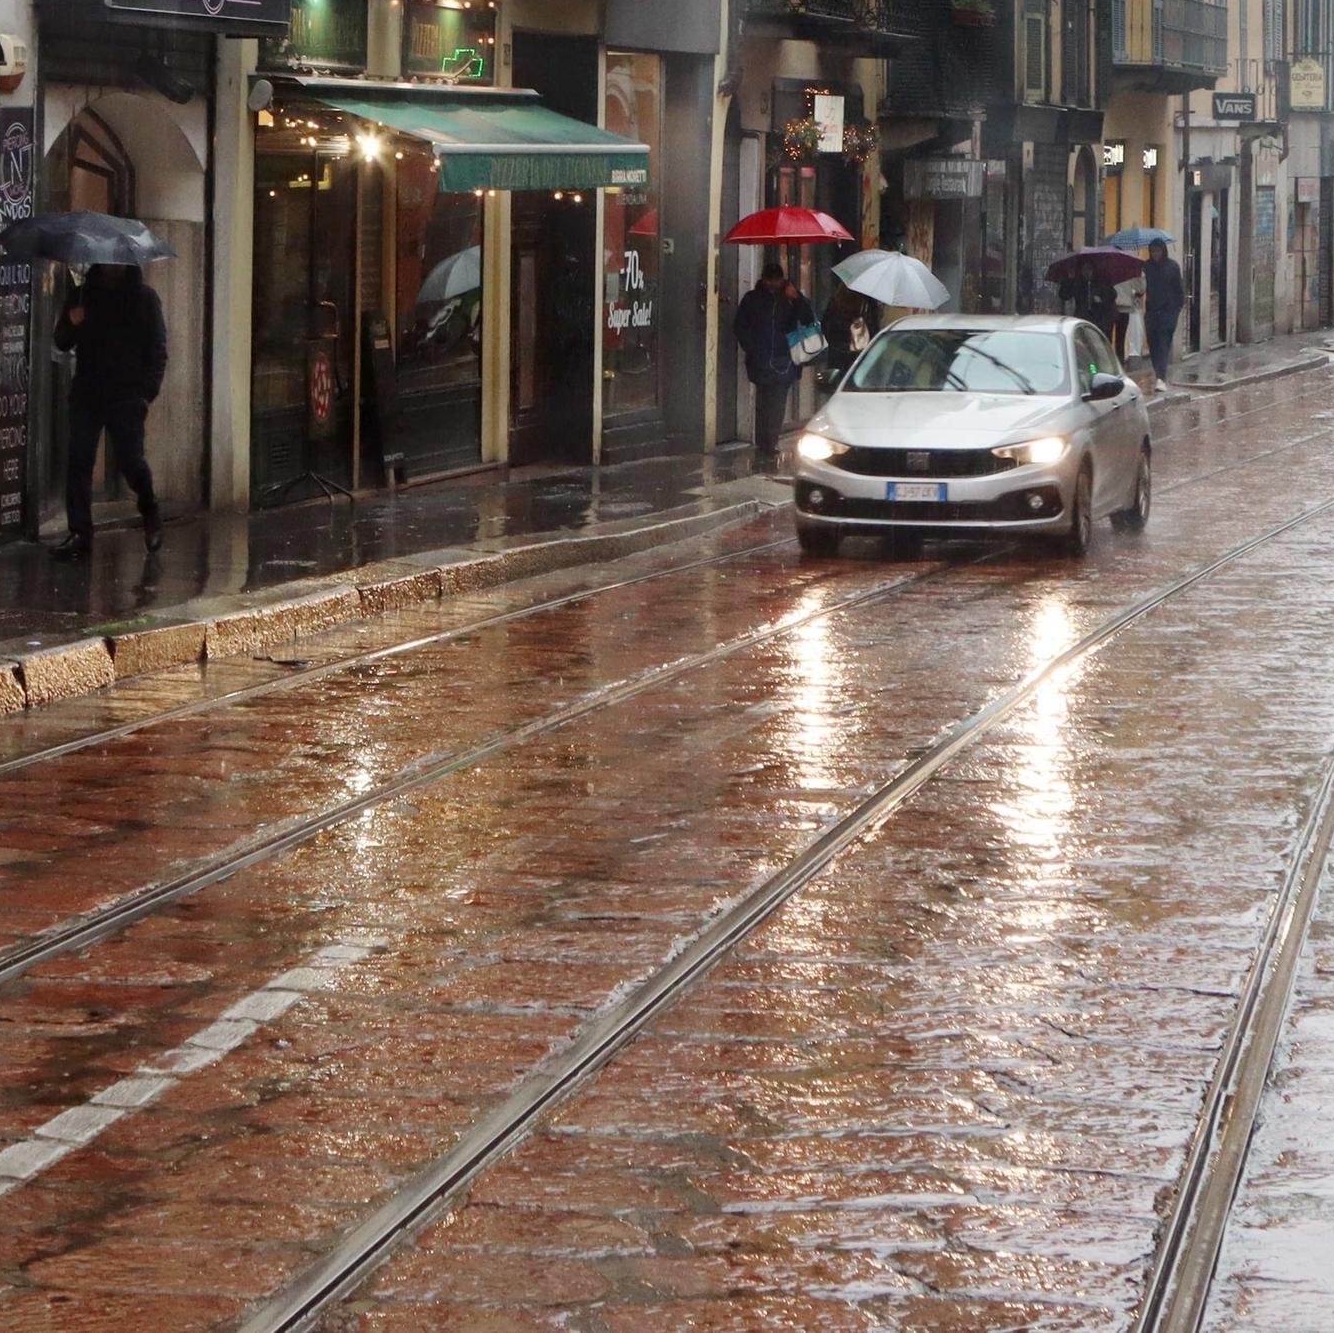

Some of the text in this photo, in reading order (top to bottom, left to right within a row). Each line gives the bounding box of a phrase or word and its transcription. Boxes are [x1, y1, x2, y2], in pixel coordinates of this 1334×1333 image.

[1215, 98, 1253, 115] VANS
[2, 130, 30, 152] PIERCING
[620, 250, 644, 292] -70%
[607, 300, 652, 336] Super Sale!
